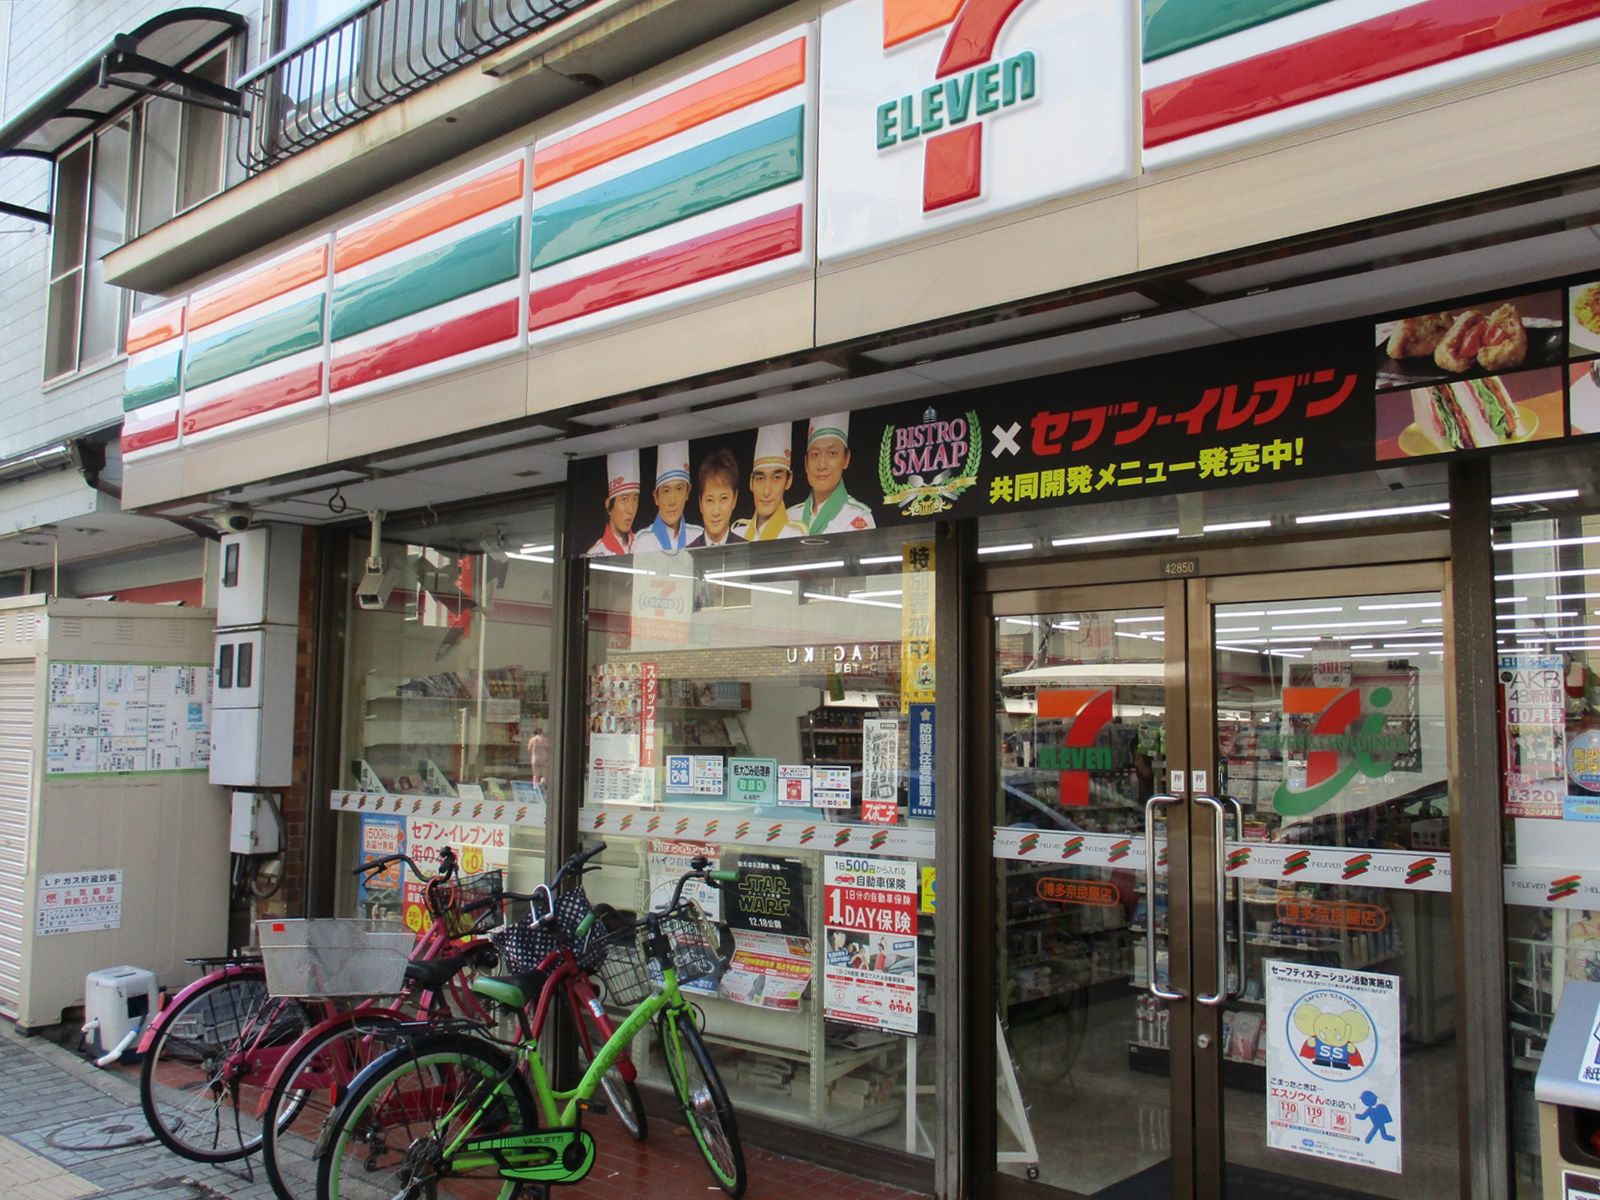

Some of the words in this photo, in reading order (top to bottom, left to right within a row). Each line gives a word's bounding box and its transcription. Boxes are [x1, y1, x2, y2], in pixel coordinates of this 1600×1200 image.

[896, 418, 967, 450] BISTRO
[892, 441, 968, 476] SMAP
[1165, 561, 1194, 574] 42850
[1510, 671, 1561, 689] AKB
[863, 804, 897, 821] スポニチ
[835, 859, 906, 876] 1日500円から入れる
[738, 874, 790, 894] STAR
[856, 875, 906, 890] 自動車保険
[739, 894, 790, 916] WARS
[845, 889, 911, 906] 1日分の自動車保険
[748, 917, 782, 929] 12.18公開
[1271, 965, 1393, 990] セーフティステーション活動実施店
[1304, 993, 1328, 1003] SAFETY
[1330, 993, 1358, 1010] STATION
[1320, 1045, 1344, 1059] SS
[1280, 1101, 1296, 1112] 110
[1306, 1106, 1323, 1117] 119
[523, 1135, 563, 1145] VAGLIETTI
